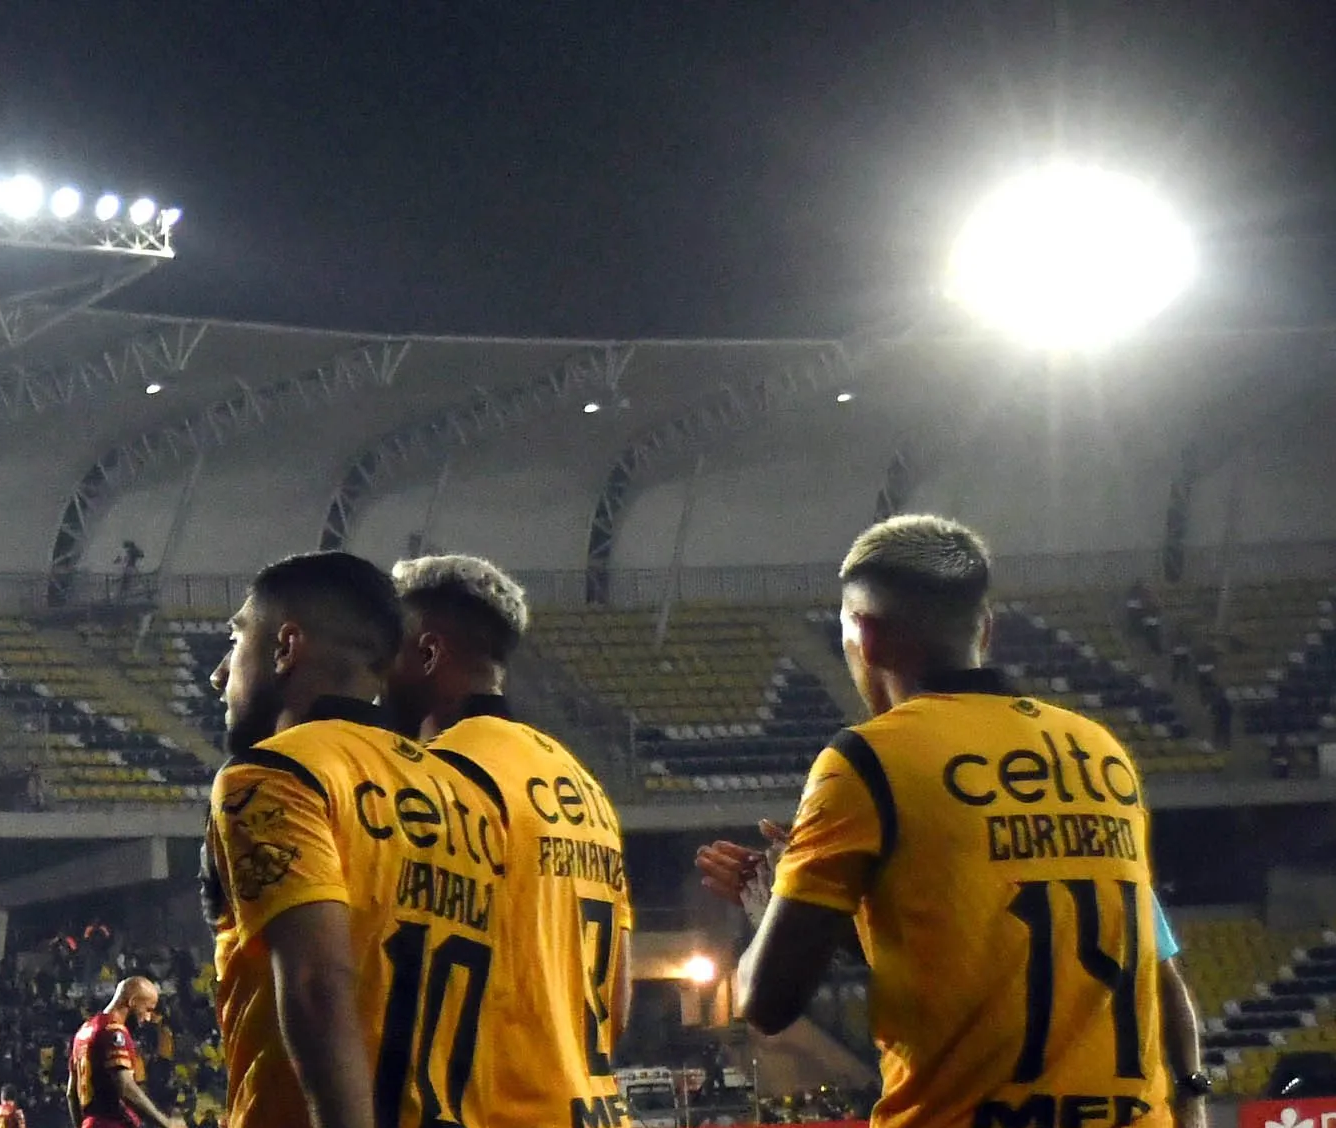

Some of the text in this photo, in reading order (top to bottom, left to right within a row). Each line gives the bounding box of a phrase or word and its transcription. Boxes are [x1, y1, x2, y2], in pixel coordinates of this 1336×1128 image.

[944, 730, 1139, 806] celta
[987, 812, 1139, 863] CORDERO
[1011, 878, 1146, 1084] 14
